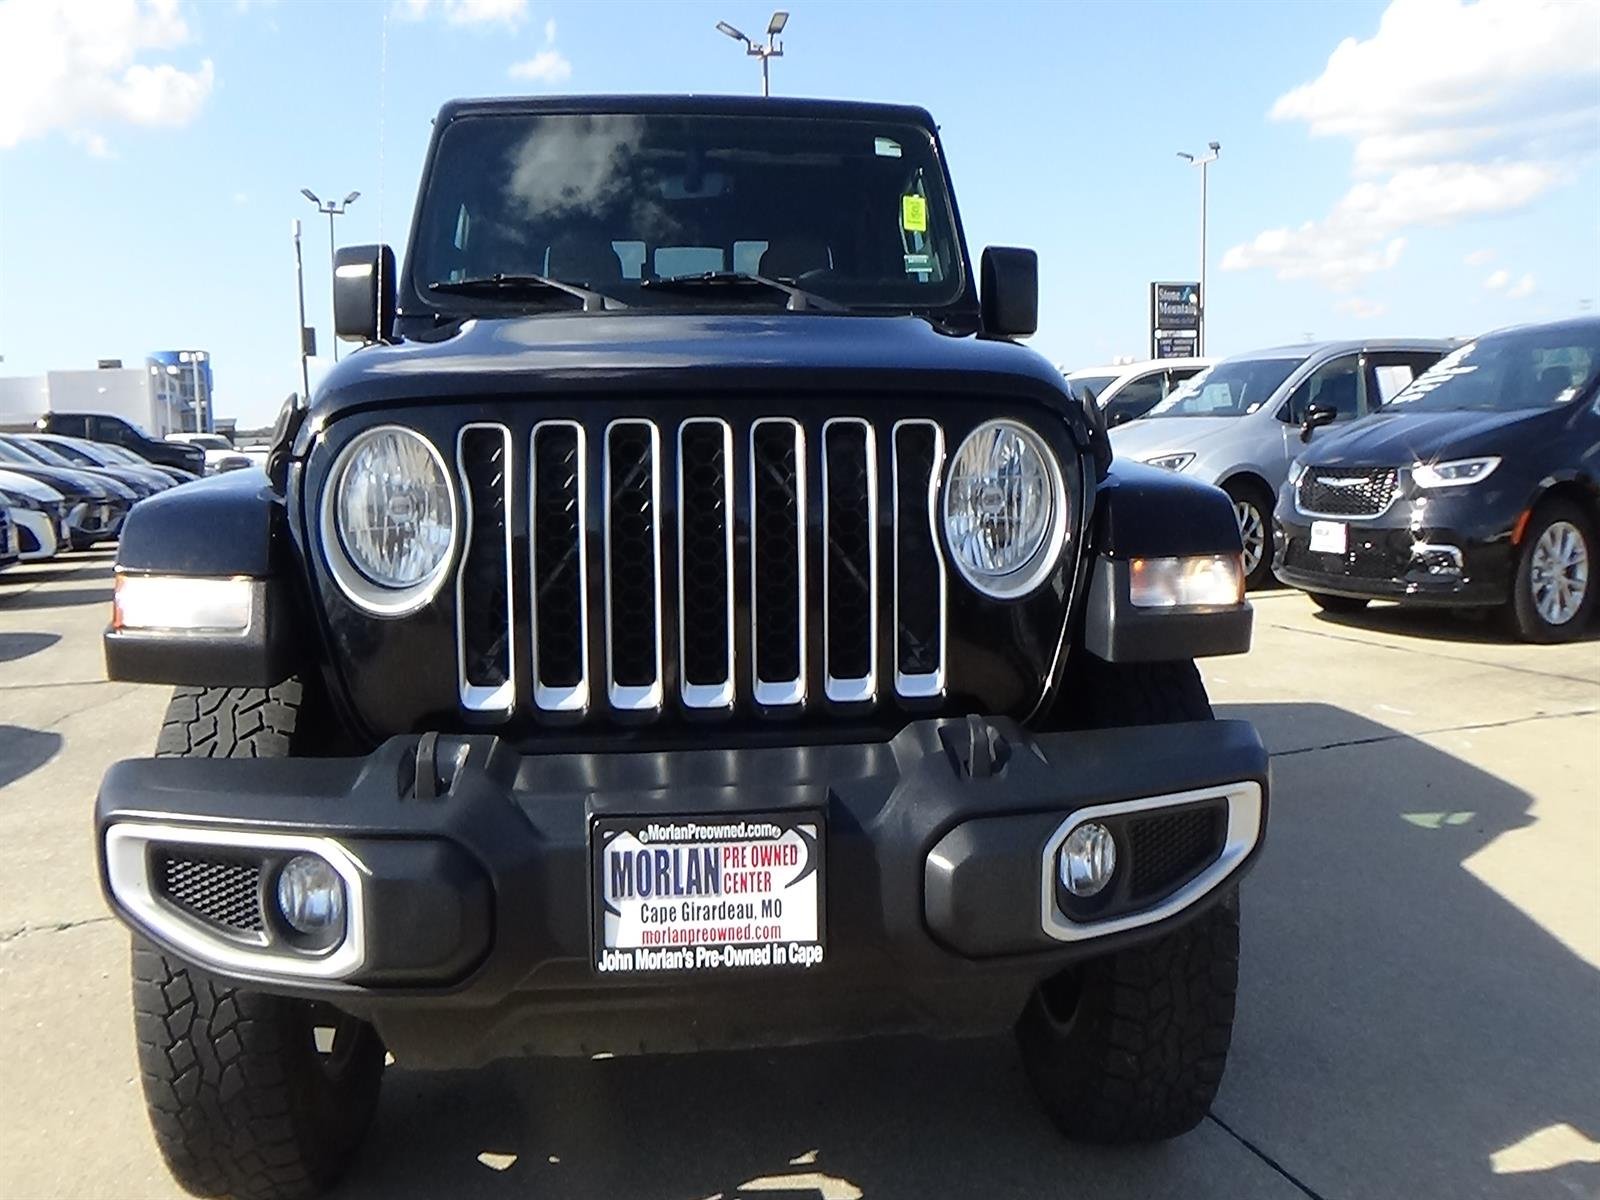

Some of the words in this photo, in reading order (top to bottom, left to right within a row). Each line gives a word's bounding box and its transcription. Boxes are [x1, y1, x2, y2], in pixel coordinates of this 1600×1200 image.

[648, 824, 772, 841] MorlanPreowned.com
[723, 847, 747, 868] PRE
[751, 844, 798, 868] OWNED
[611, 847, 722, 898] MORLAN
[724, 871, 771, 894] CENTER
[641, 902, 677, 925] Cape
[682, 900, 757, 922] Girardeau,
[762, 898, 782, 918] MO
[642, 924, 782, 946] morlanpreowned.com
[598, 949, 633, 972] John
[636, 947, 694, 970] Morlan's
[697, 944, 770, 968] Pre-Owned
[789, 941, 824, 967] Cape
